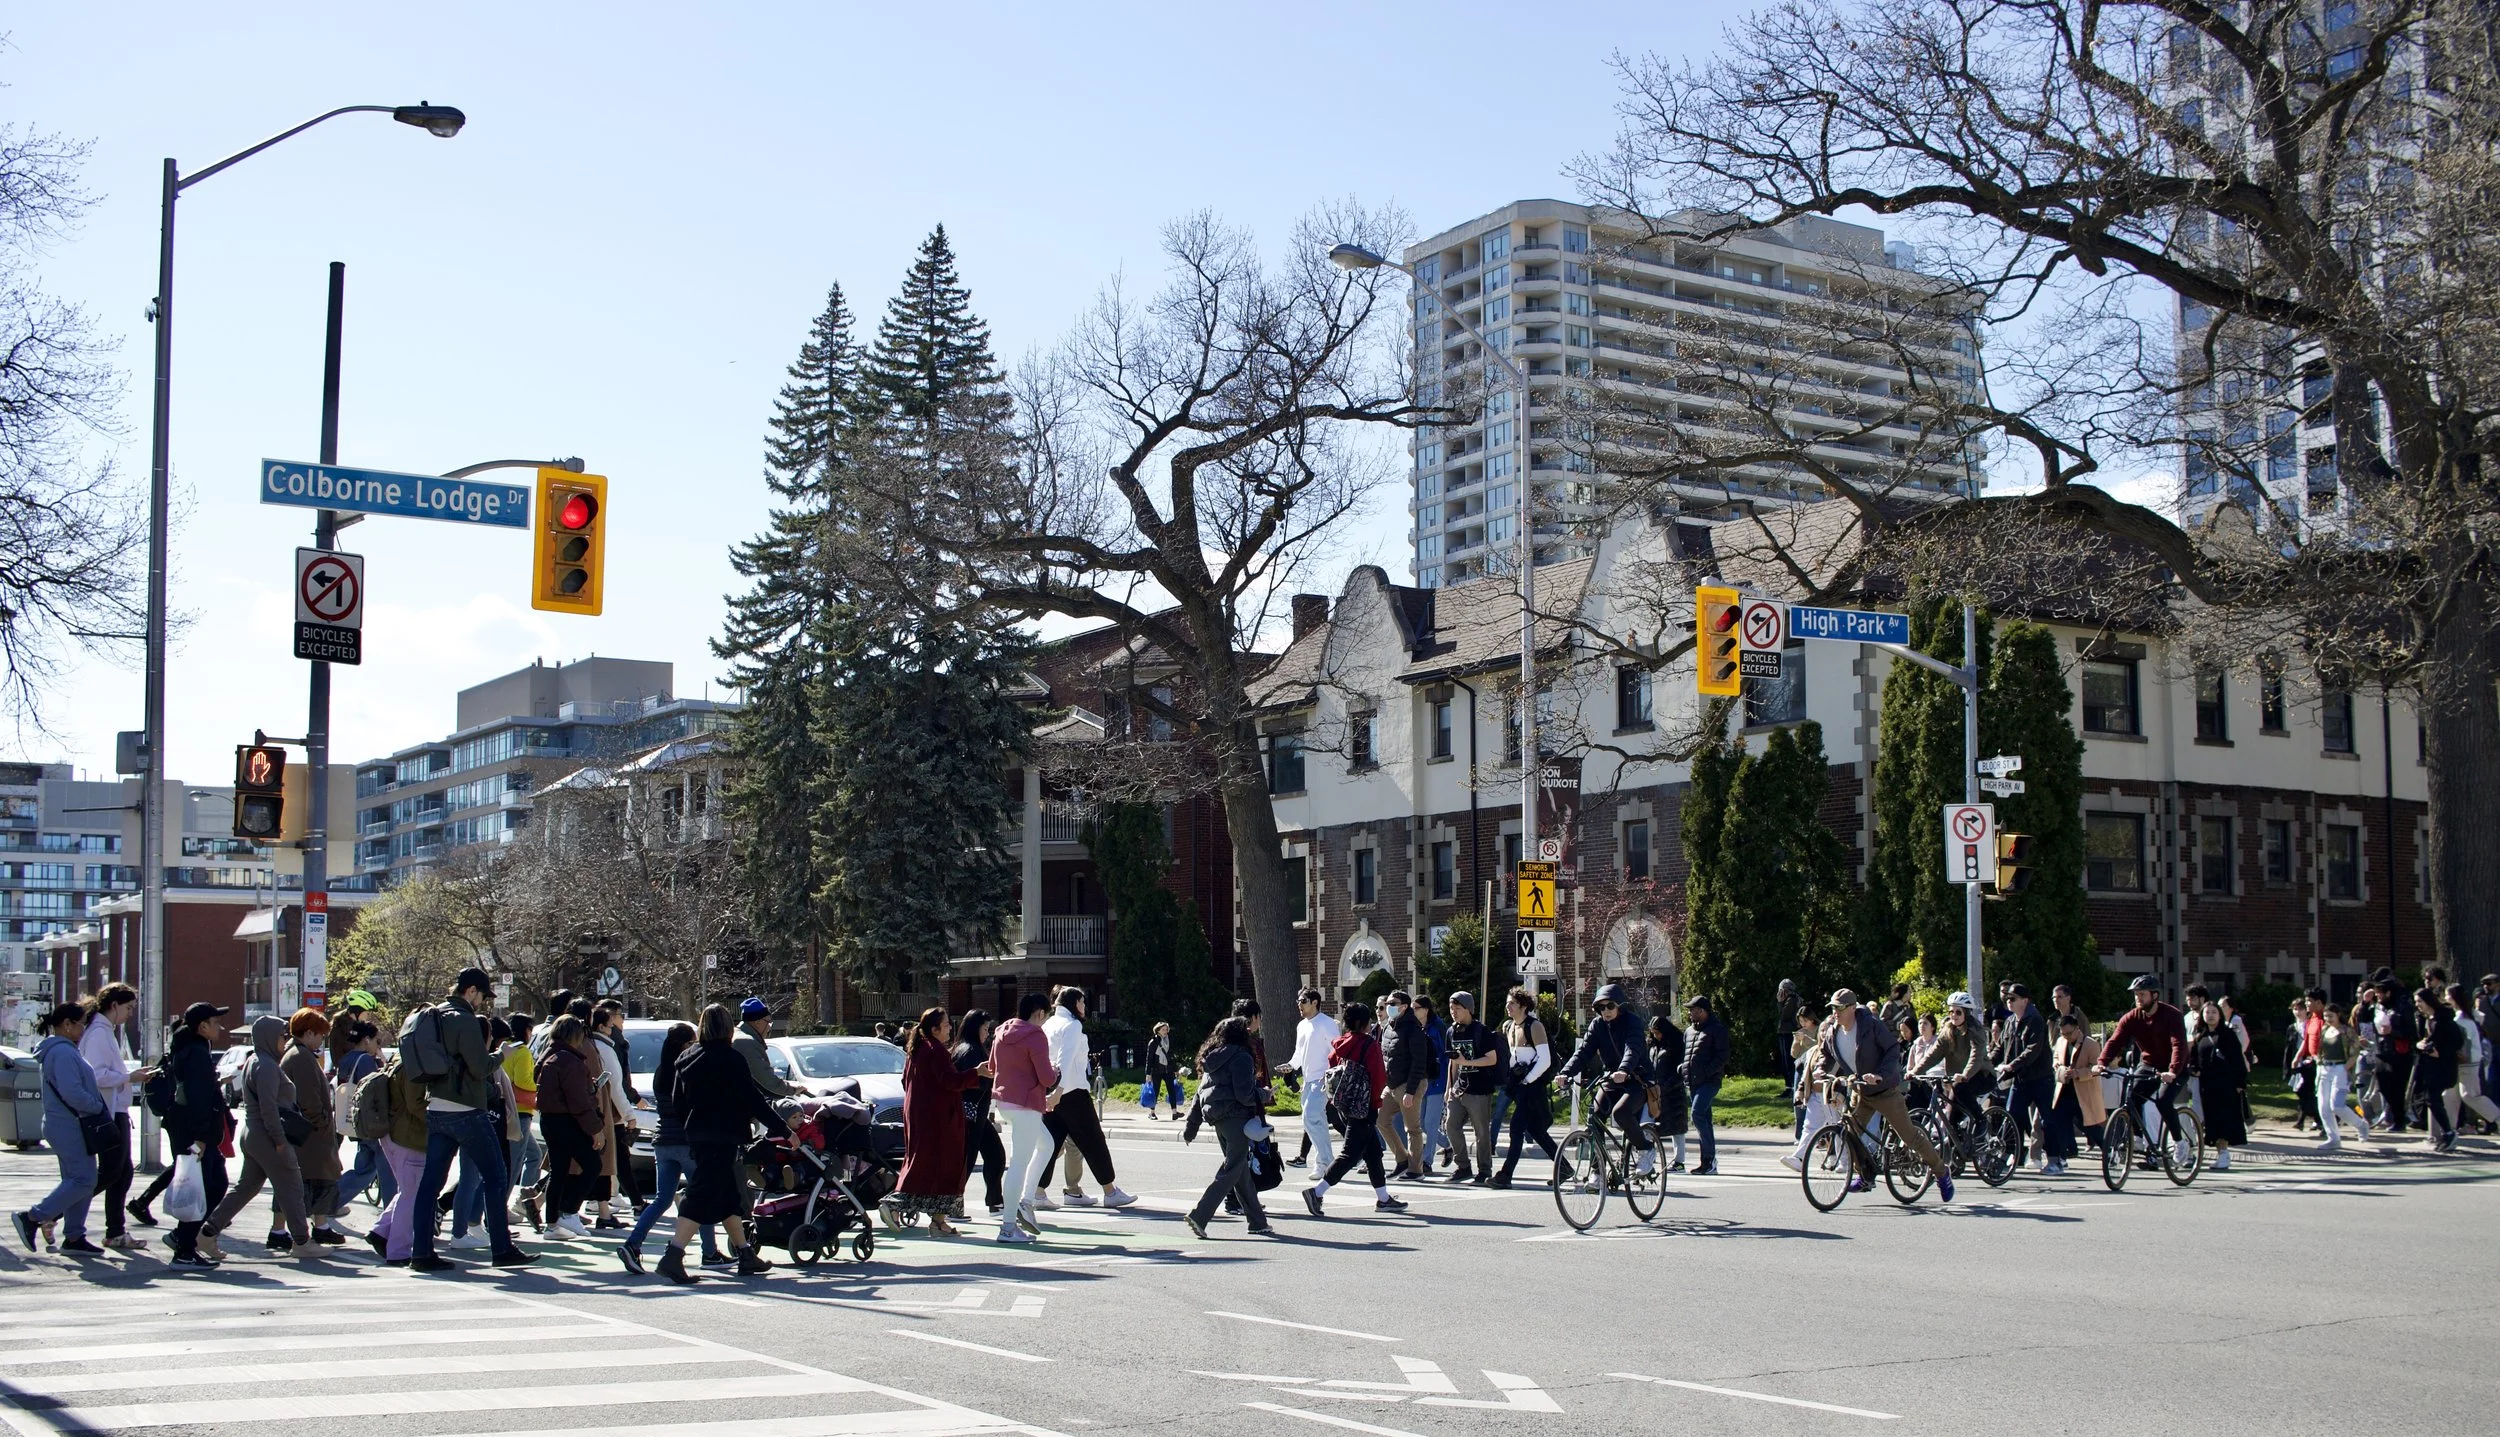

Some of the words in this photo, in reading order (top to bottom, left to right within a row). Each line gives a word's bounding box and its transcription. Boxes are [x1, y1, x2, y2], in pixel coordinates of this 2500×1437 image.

[268, 465, 401, 505] Colborne
[416, 480, 500, 521] Lodge
[508, 490, 524, 504] Dr
[1801, 610, 1838, 636] High
[1847, 613, 1884, 635] Park
[1888, 617, 1899, 627] Av
[302, 627, 354, 644] BICYCLES
[299, 642, 357, 659] EXCEPTED
[1743, 653, 1777, 664] BICYCLES
[1741, 663, 1779, 675] EXCEPTED
[1982, 761, 2001, 771] BLOOR
[1540, 768, 1560, 778] DON
[1540, 778, 1578, 788] QUIXOTE
[1984, 781, 1997, 789] HIGH
[1998, 782, 2012, 790] PARK
[1525, 864, 1548, 872] SENIORS
[1520, 870, 1539, 878] SAFETY
[1541, 871, 1554, 879] ZONE
[1520, 918, 1534, 927] DRIVE
[1535, 919, 1554, 927] SLOWLY
[18, 1090, 34, 1099] Litter
